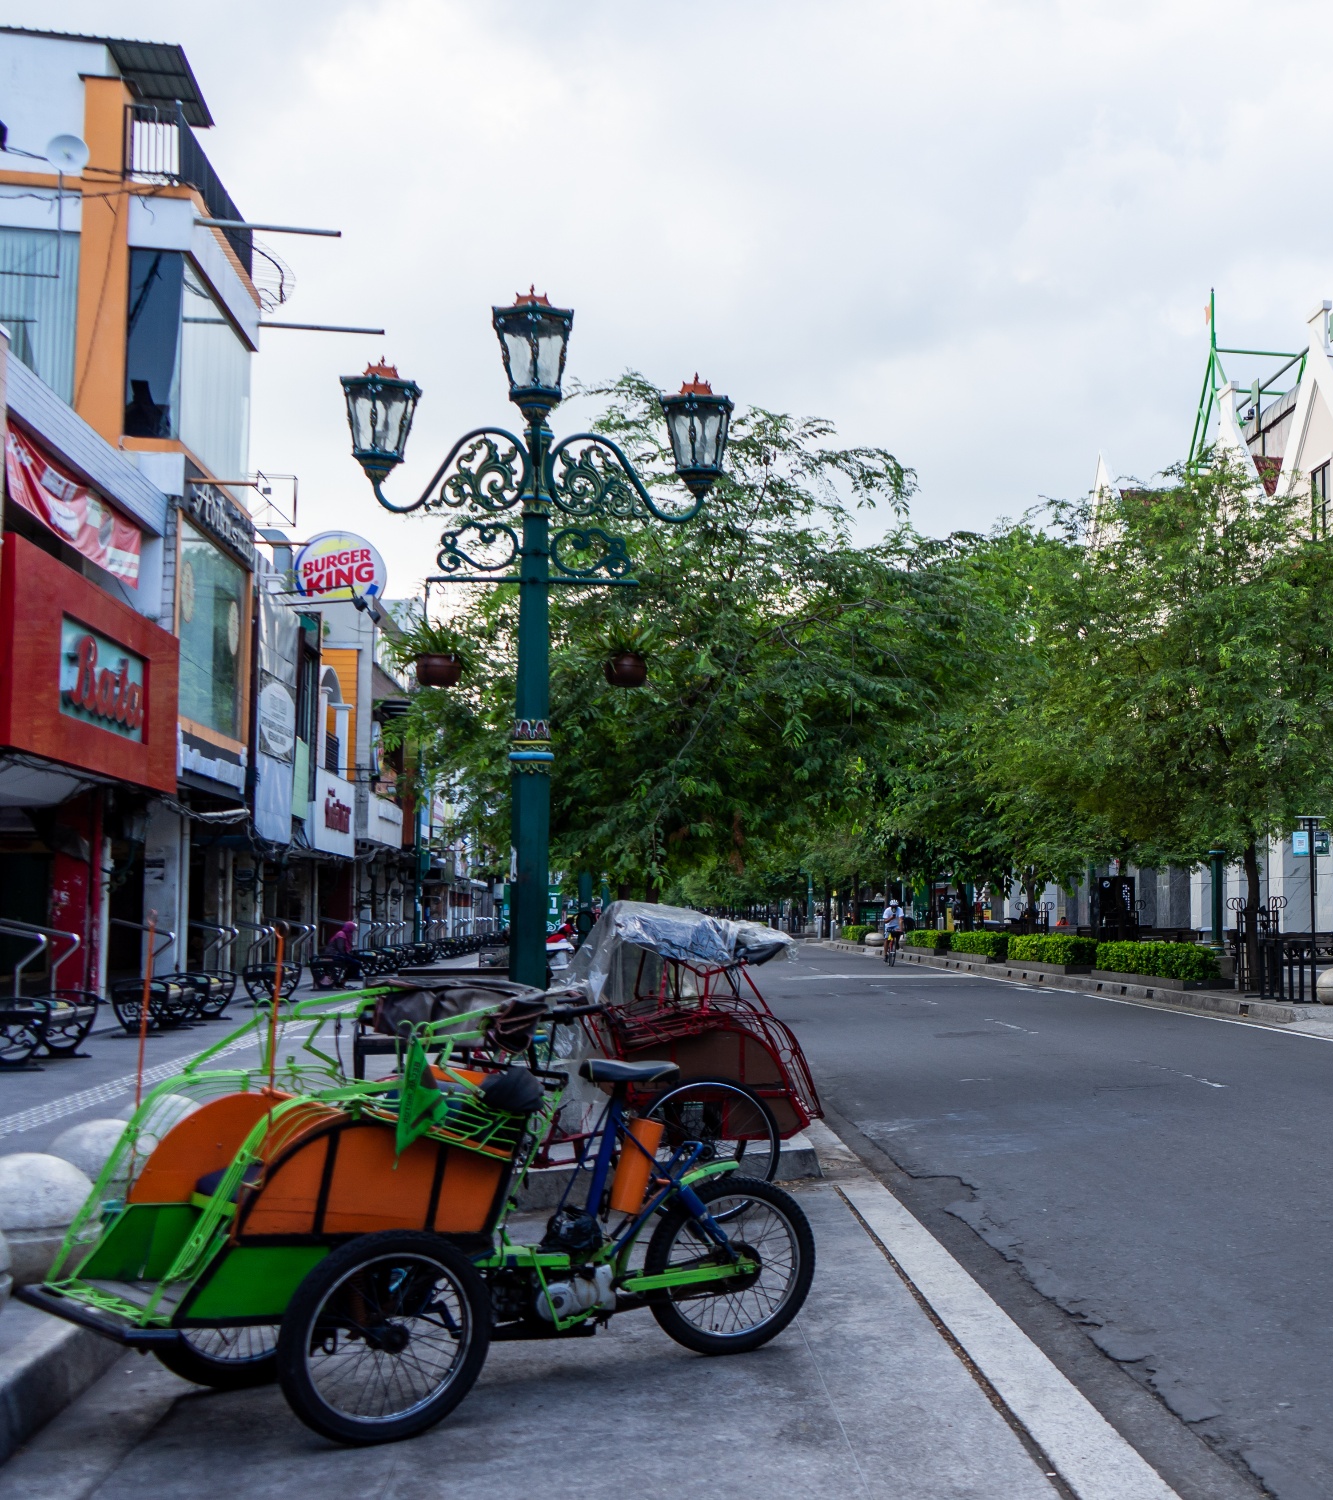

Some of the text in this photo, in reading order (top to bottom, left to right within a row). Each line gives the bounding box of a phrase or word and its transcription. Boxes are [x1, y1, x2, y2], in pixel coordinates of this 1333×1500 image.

[303, 549, 371, 578] BURGER
[306, 562, 374, 597] KING
[70, 635, 142, 729] Bata
